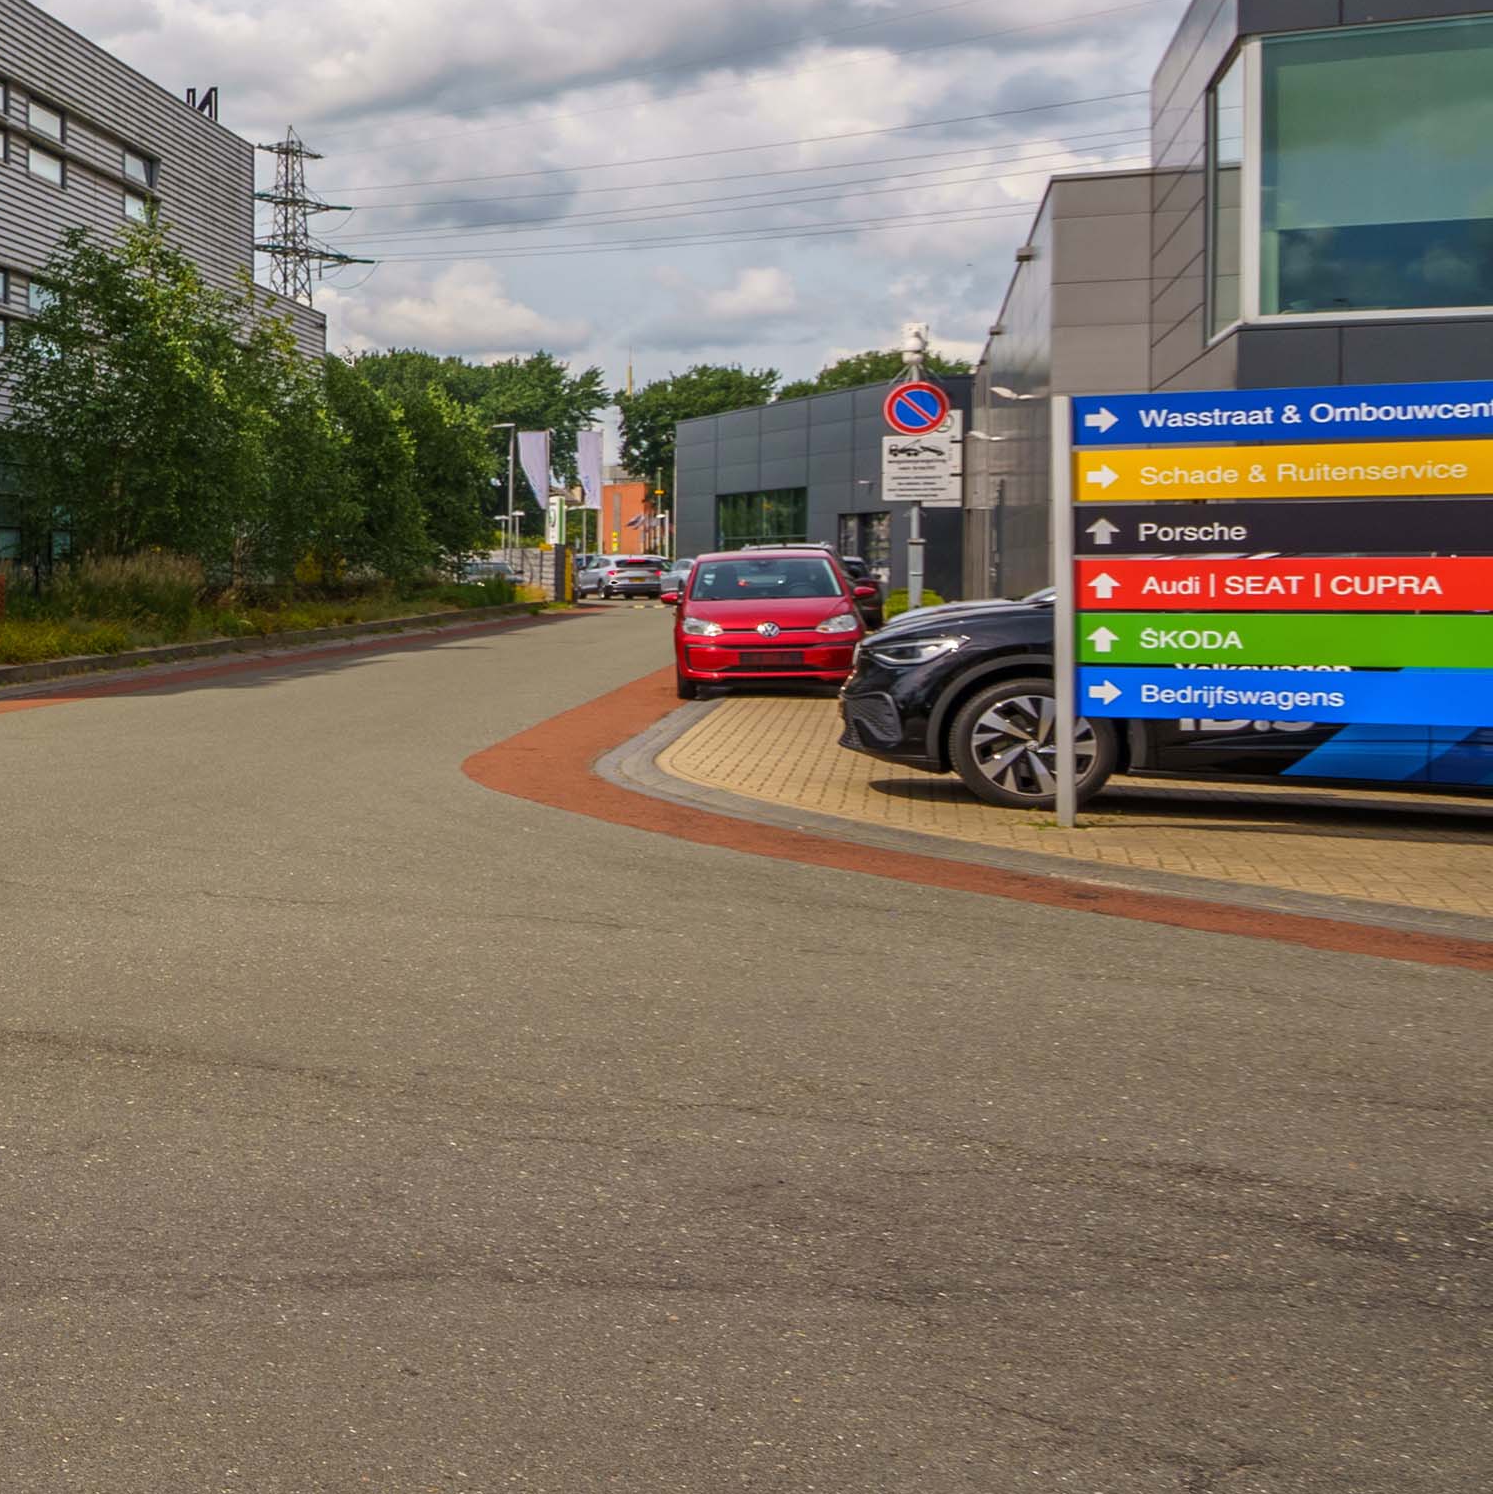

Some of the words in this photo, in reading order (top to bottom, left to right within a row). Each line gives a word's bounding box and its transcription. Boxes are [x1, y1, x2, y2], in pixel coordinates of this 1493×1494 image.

[1139, 406, 1275, 428] Wasstraat
[1280, 404, 1302, 425] &
[1140, 465, 1239, 486] Schade
[1248, 463, 1267, 484] &
[1276, 460, 1469, 484] Ruitenservice
[1138, 521, 1248, 542] Porsche
[1140, 575, 1202, 596] Audi
[1223, 575, 1305, 596] SEAT
[1330, 575, 1444, 596] CUPRA
[1139, 627, 1244, 650] ŠKODA
[1140, 683, 1346, 711] Bedrijfswagens
